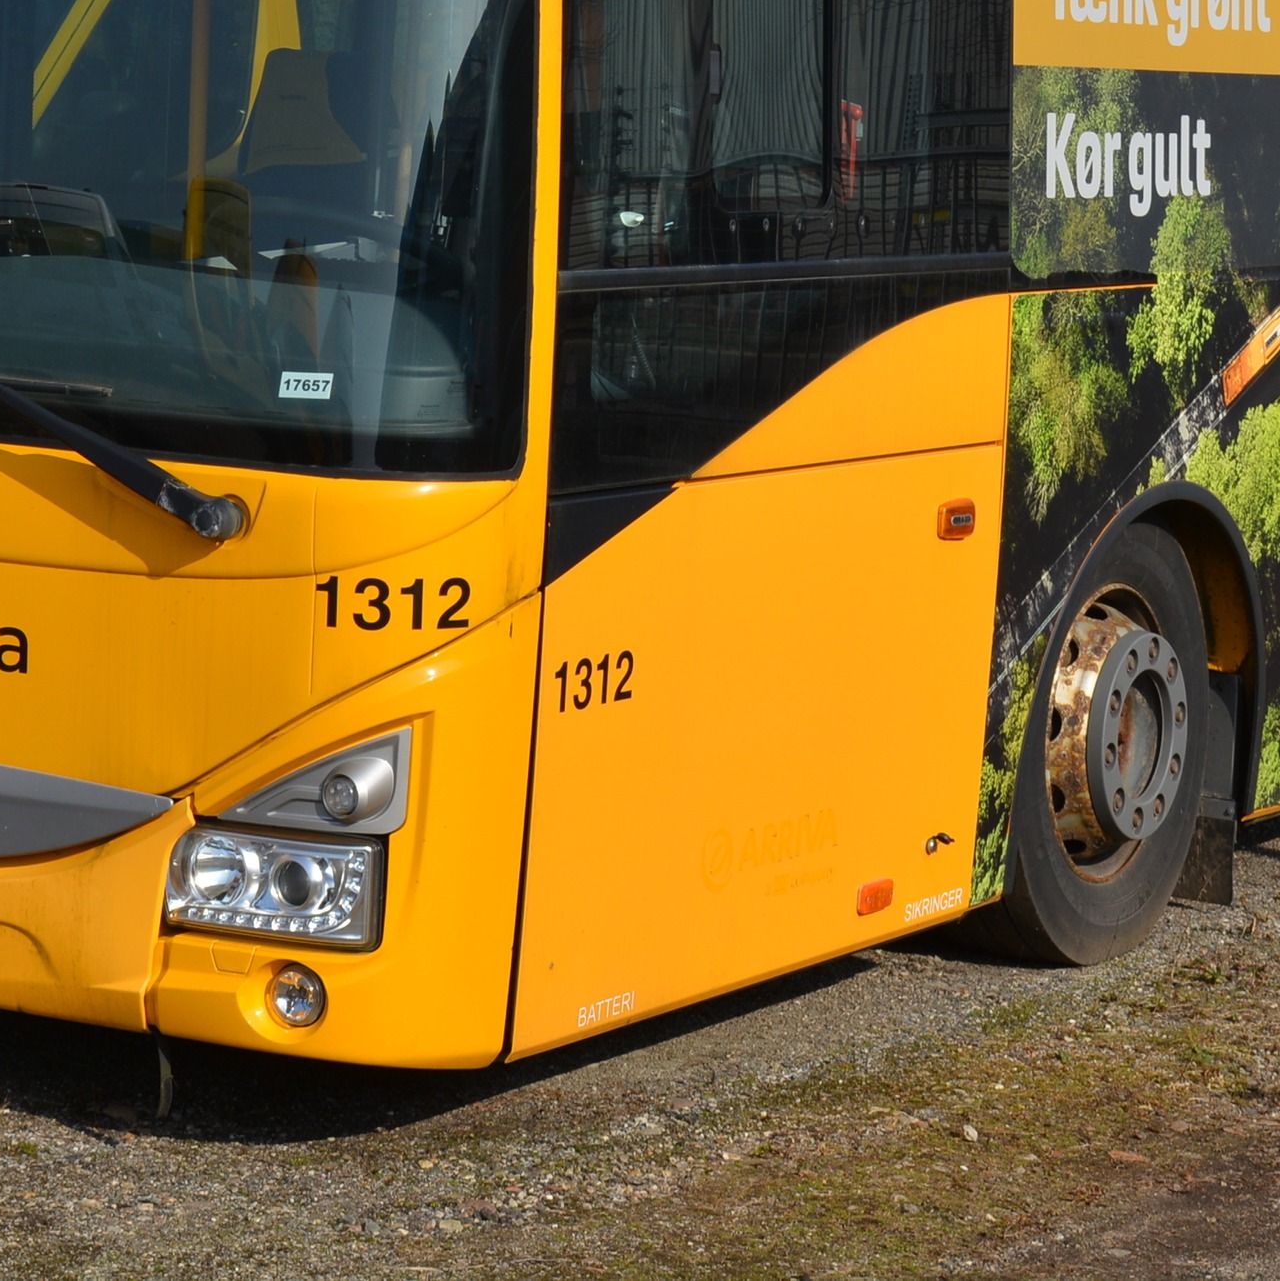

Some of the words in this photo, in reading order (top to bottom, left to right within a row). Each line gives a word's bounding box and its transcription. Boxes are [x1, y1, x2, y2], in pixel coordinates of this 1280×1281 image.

[1046, 112, 1121, 199] Kør
[1129, 115, 1211, 217] gult
[283, 378, 331, 393] 17657
[316, 575, 471, 631] 1312
[555, 650, 634, 713] 1312
[904, 887, 963, 923] SIKRINGER
[577, 991, 636, 1028] BATTERI
